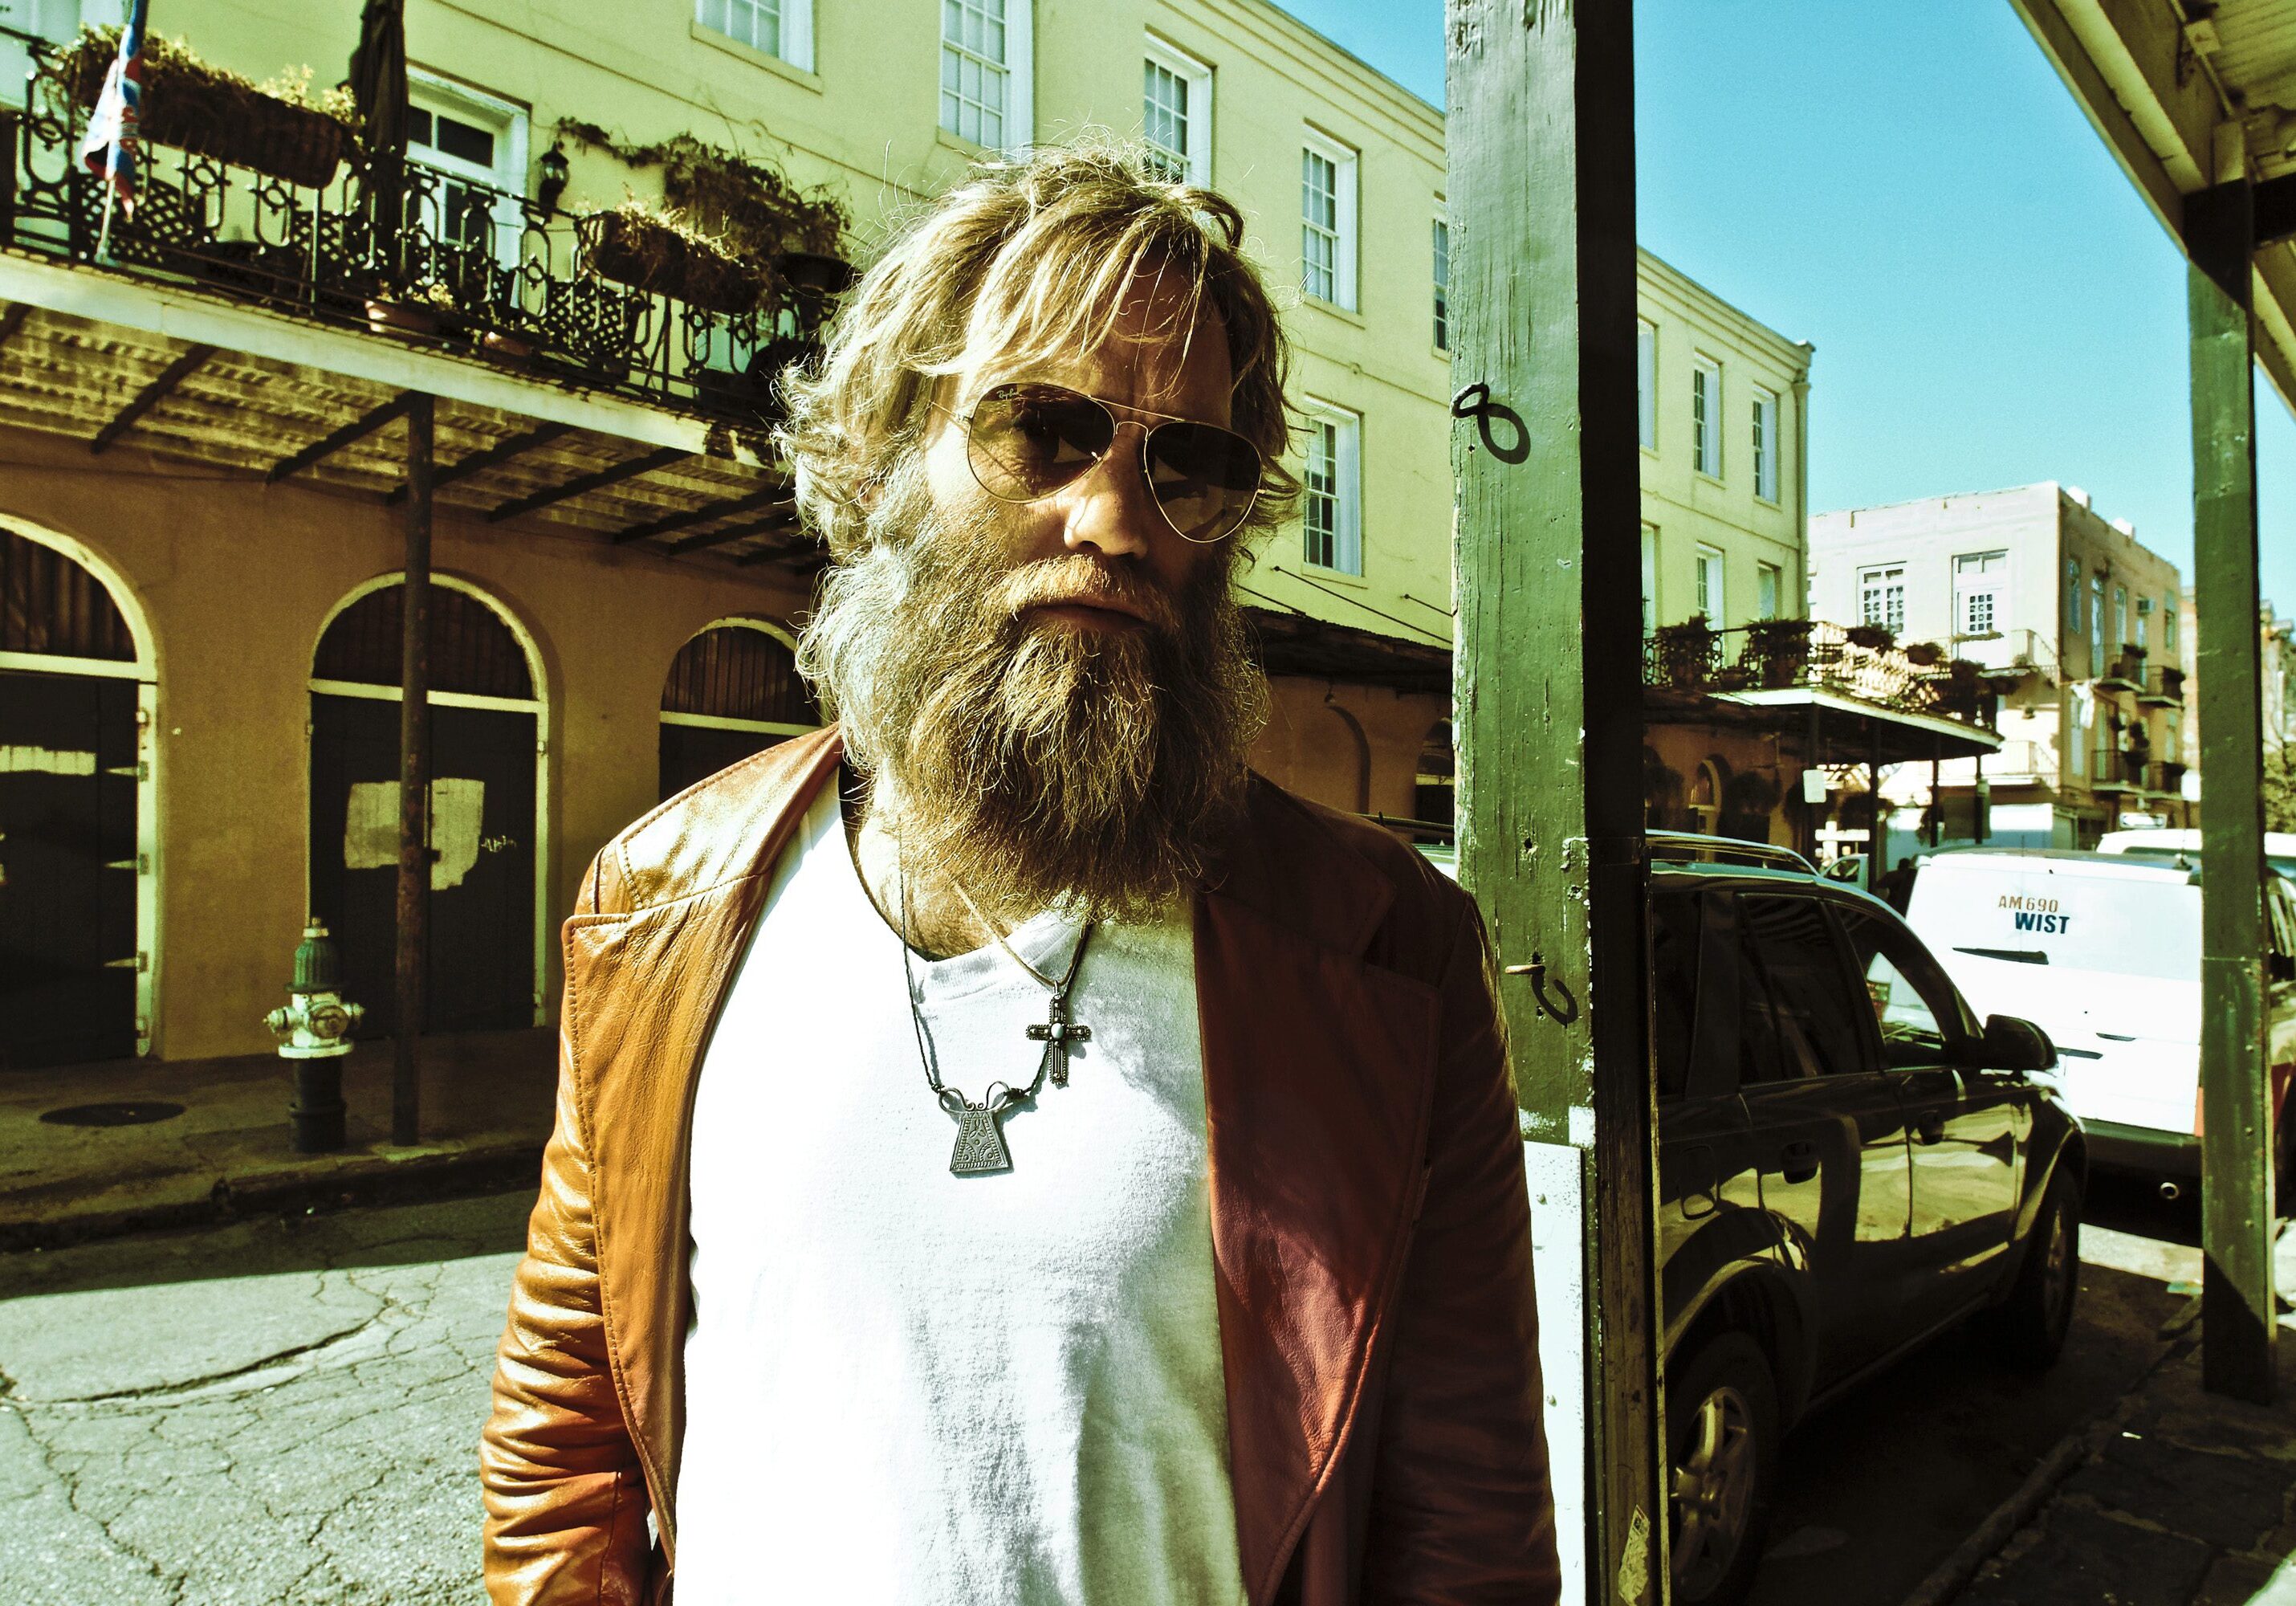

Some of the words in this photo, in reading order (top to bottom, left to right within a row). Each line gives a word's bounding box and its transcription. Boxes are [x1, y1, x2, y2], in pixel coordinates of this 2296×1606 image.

[1998, 895, 2022, 910] AM
[2026, 897, 2058, 912] 690
[2015, 911, 2070, 934] WIST
